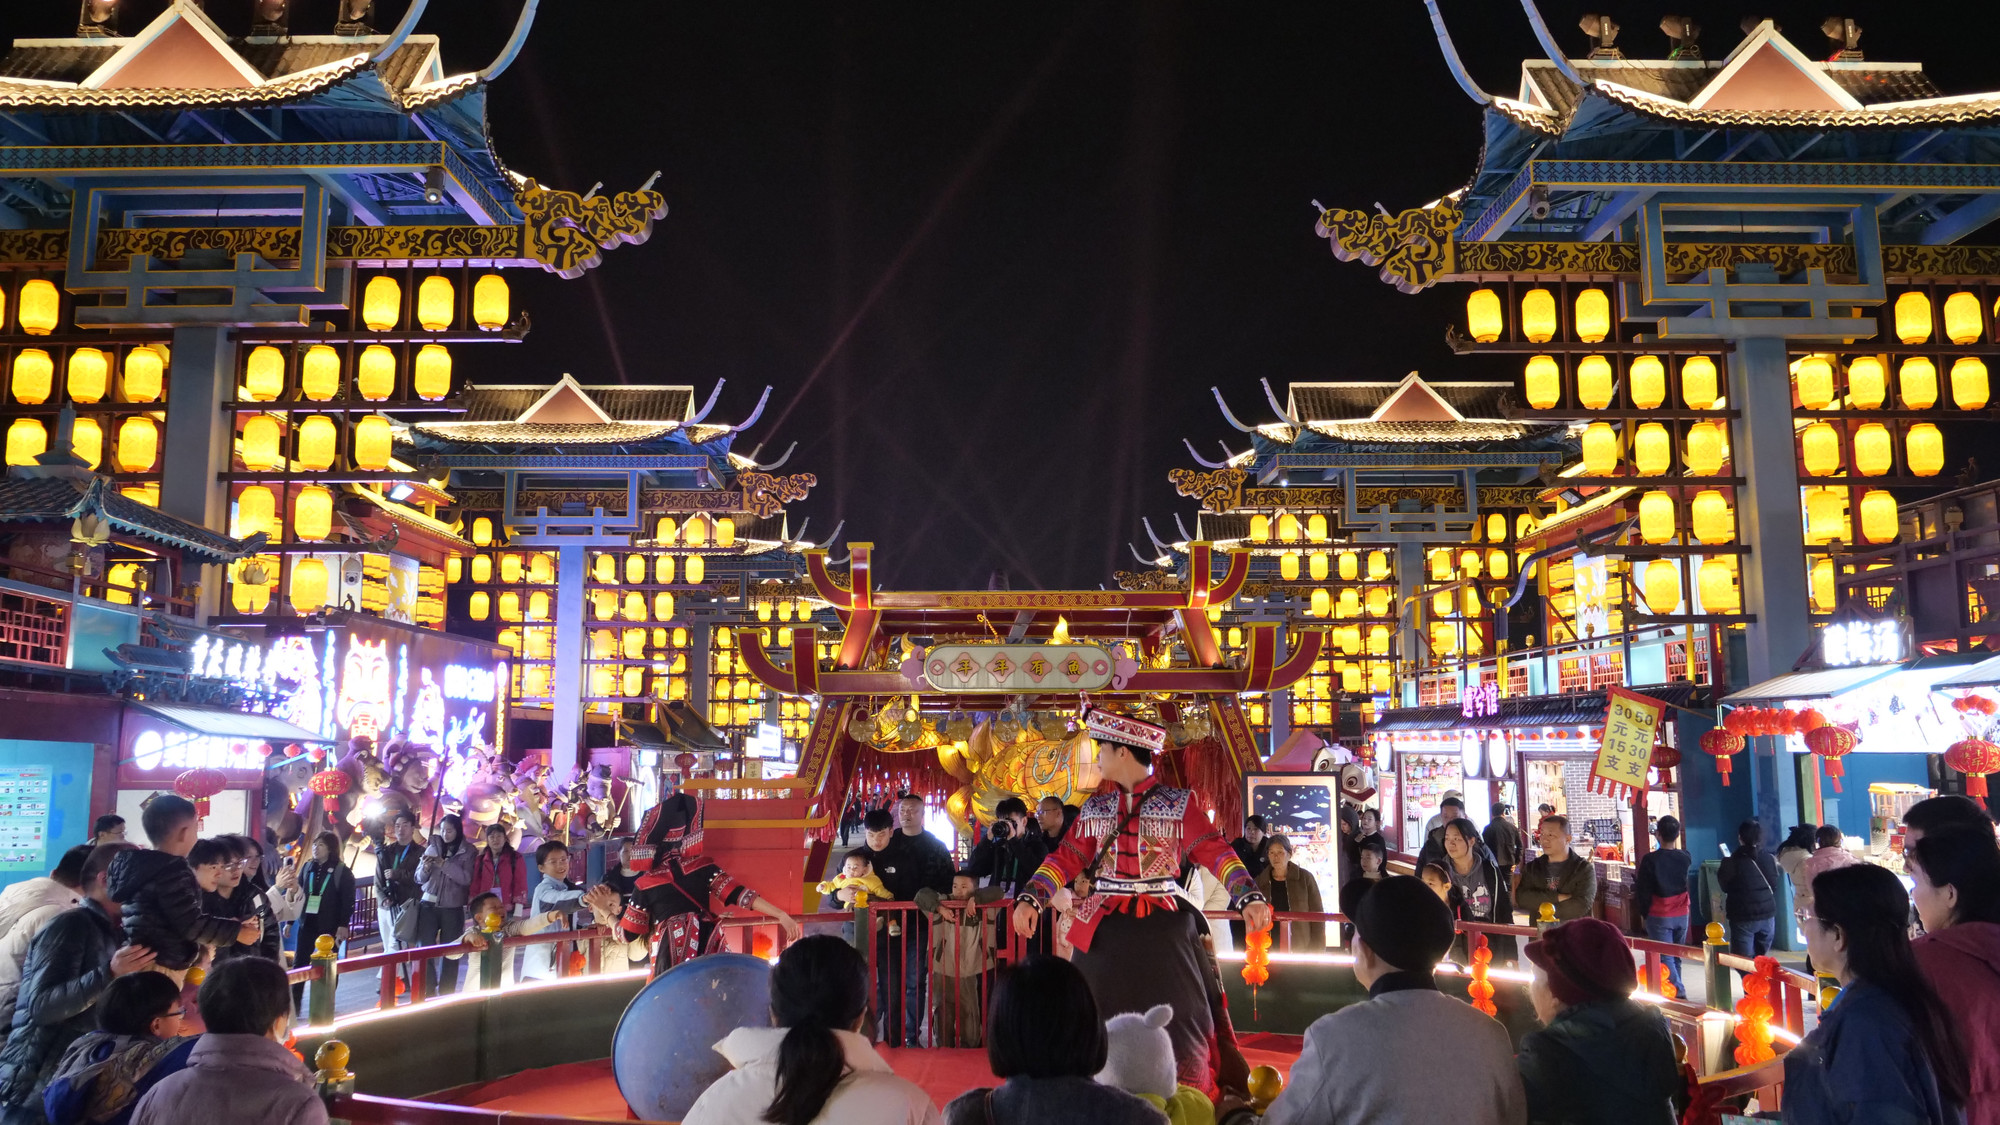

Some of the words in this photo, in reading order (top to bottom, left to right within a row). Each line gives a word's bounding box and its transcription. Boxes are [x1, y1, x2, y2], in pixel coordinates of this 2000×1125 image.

[956, 659, 1081, 676] 年年有魚
[1614, 704, 1632, 719] 30
[1635, 711, 1653, 726] 50
[1612, 721, 1628, 737] 元
[1634, 728, 1649, 743] 元
[1609, 738, 1626, 753] 15
[1629, 745, 1647, 760] 30
[1604, 755, 1621, 771] 支
[1626, 761, 1642, 777] 支
